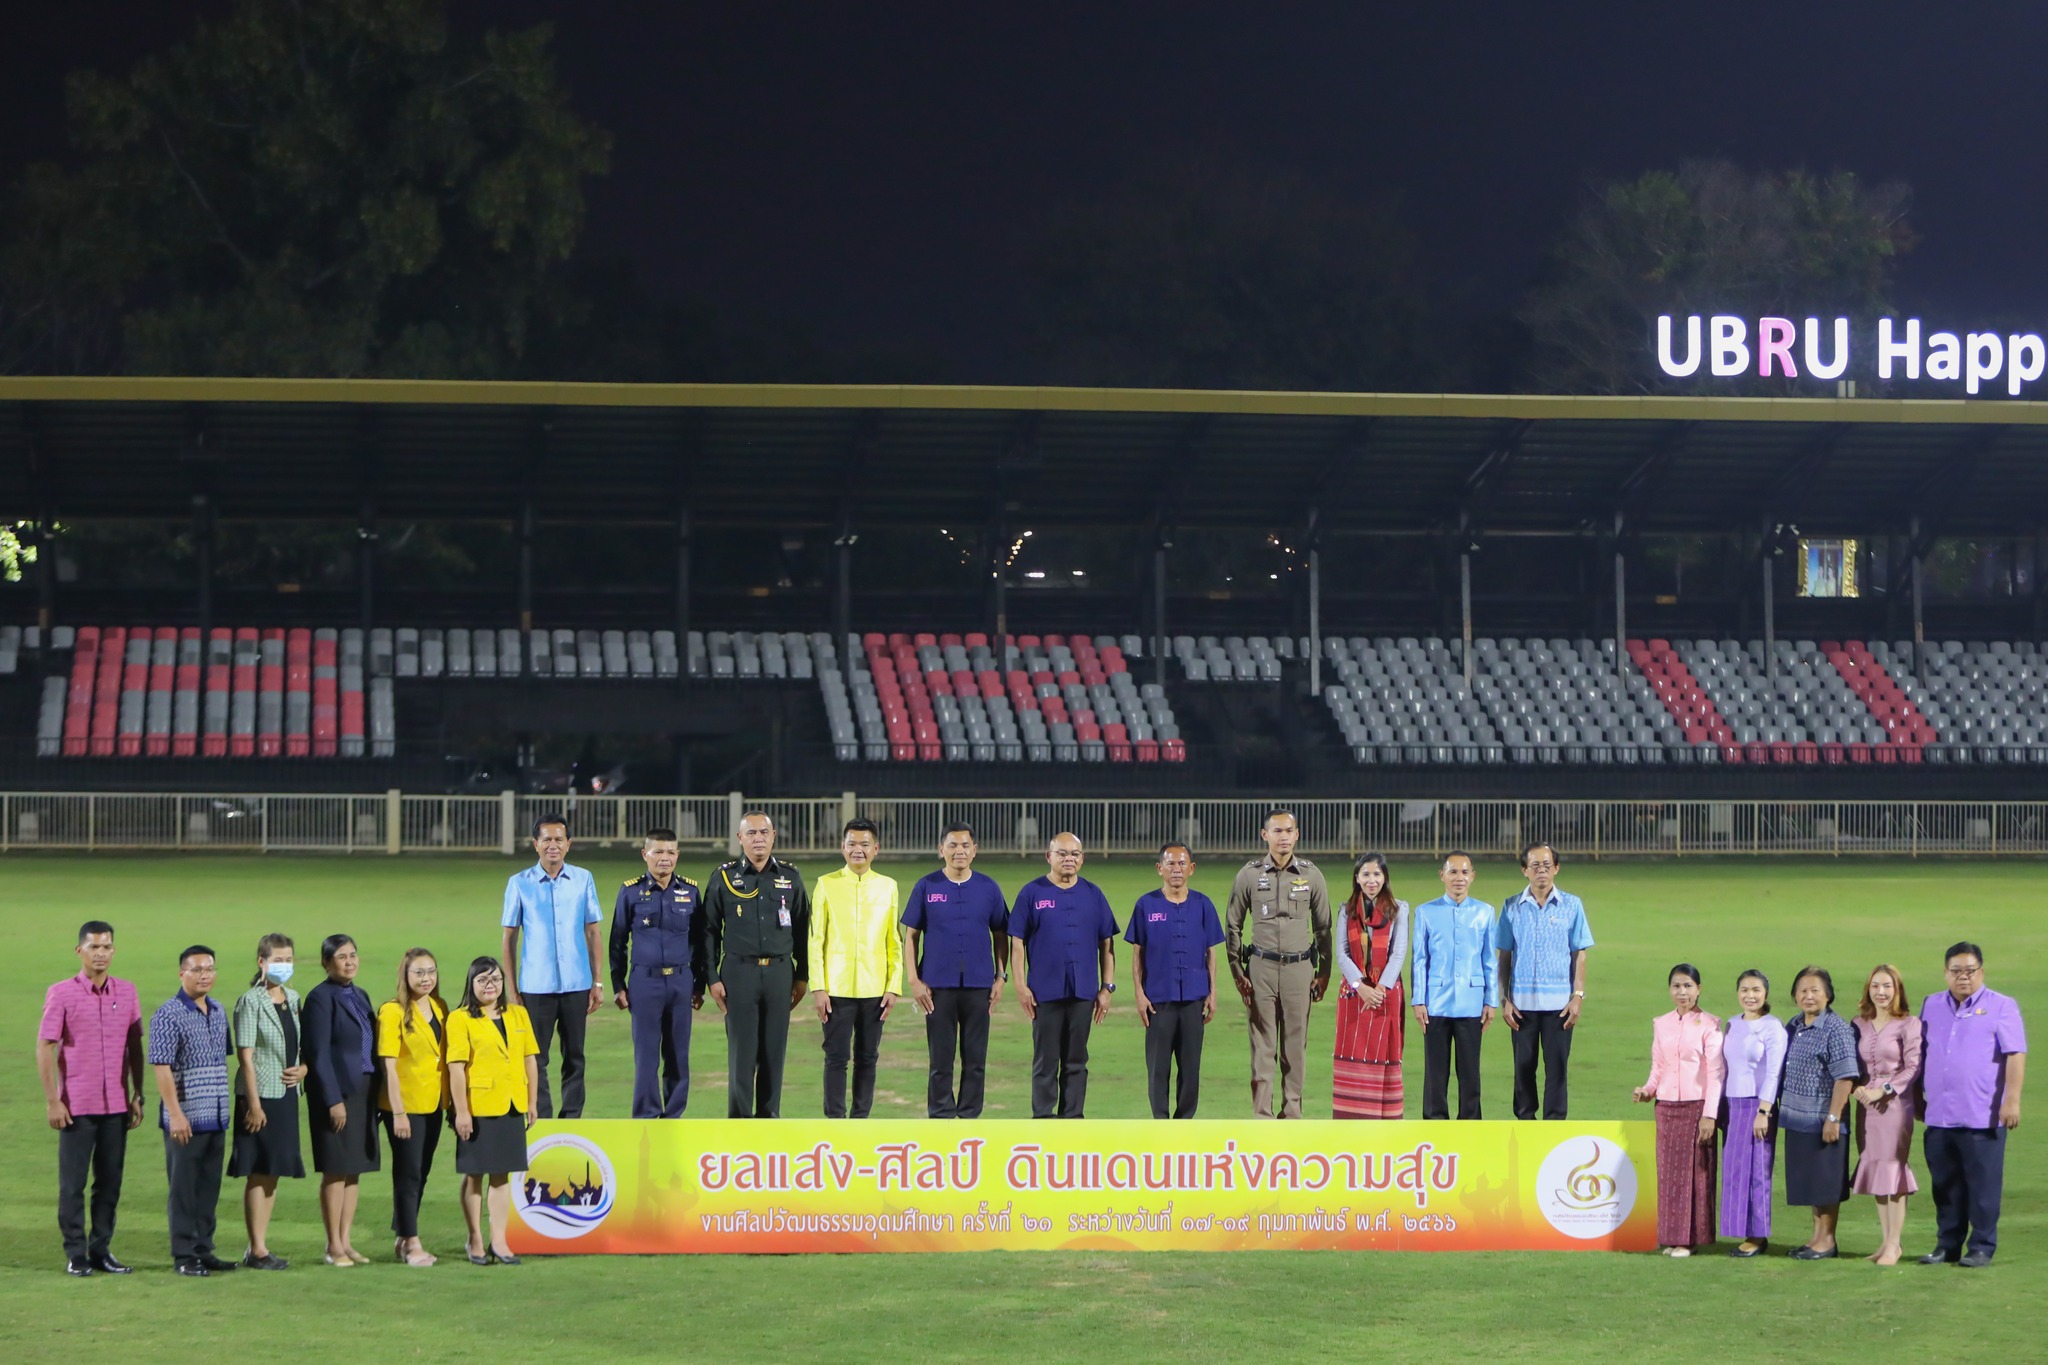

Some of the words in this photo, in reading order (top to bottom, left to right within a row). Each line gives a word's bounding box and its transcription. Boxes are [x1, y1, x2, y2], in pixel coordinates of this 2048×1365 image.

[1657, 314, 1849, 380] UBRU
[1878, 316, 2046, 396] Happ
[927, 893, 948, 903] UBRU
[1035, 899, 1056, 910] UBRU
[1148, 912, 1168, 922] UBRU
[699, 1140, 983, 1190] ยลแสง-ศิลป์
[1006, 1142, 1456, 1206] ดินแดนแห่งความสุข
[701, 1206, 955, 1240] งานศิลปวัฒนธรรมอุดมศึกษา
[962, 1200, 1012, 1233] ครั้งที่
[1020, 1213, 1053, 1233] ๒๑
[1068, 1200, 1173, 1233] ระหว่างวันที่
[1181, 1212, 1251, 1232] ๑๗-๑๙
[1258, 1206, 1351, 1240] กุมภาพันธ์
[1355, 1208, 1393, 1233] พ.ศ.
[1400, 1213, 1458, 1233] ๒๕๖๖
